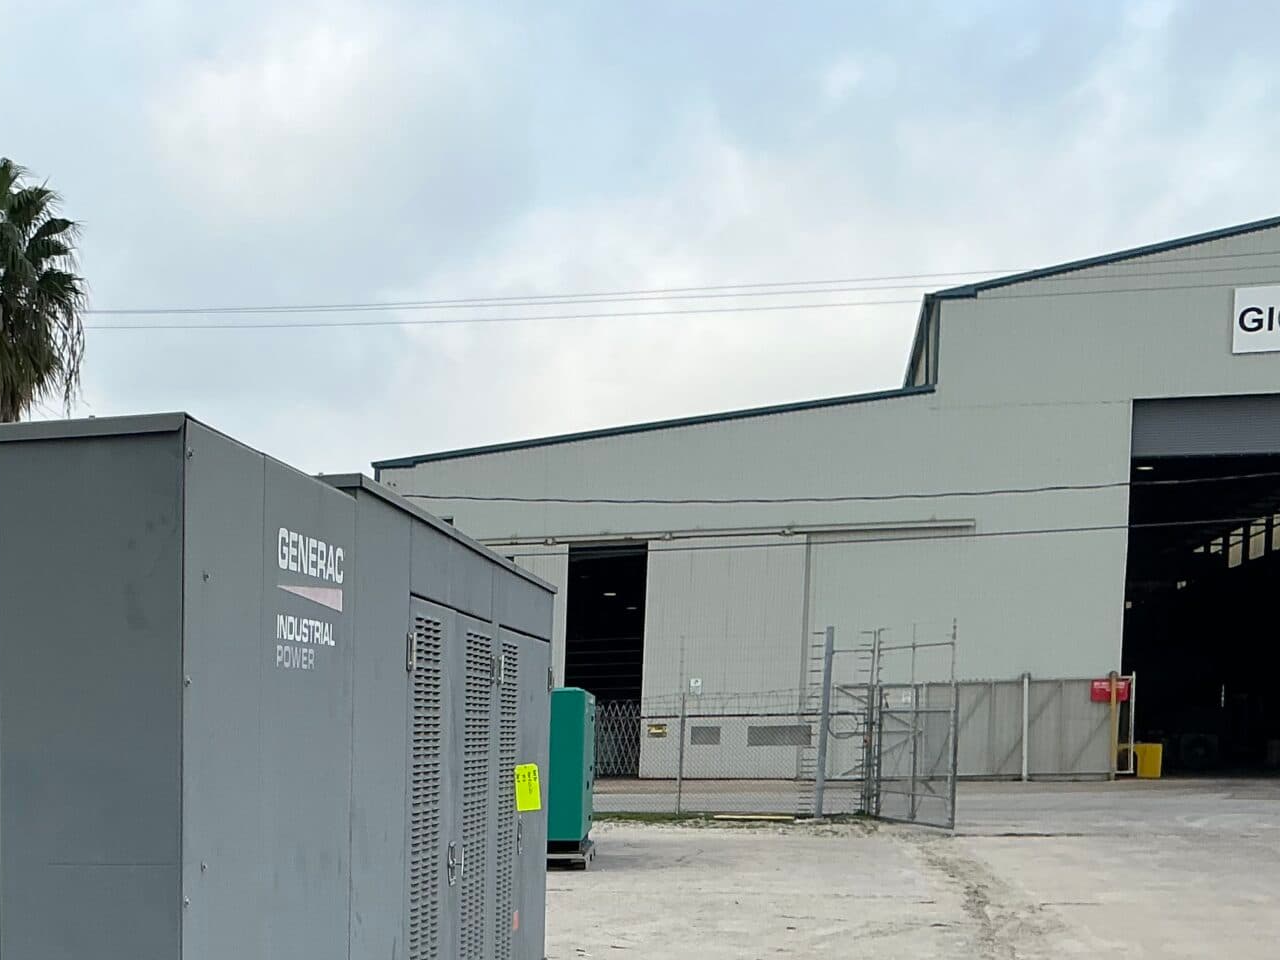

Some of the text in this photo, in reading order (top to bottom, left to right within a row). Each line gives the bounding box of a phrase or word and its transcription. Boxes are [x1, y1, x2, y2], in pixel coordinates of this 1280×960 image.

[1239, 306, 1280, 332] GI
[278, 528, 344, 584] GENERAC
[276, 614, 336, 646] INDUSTRIAL
[276, 644, 315, 670] POWER
